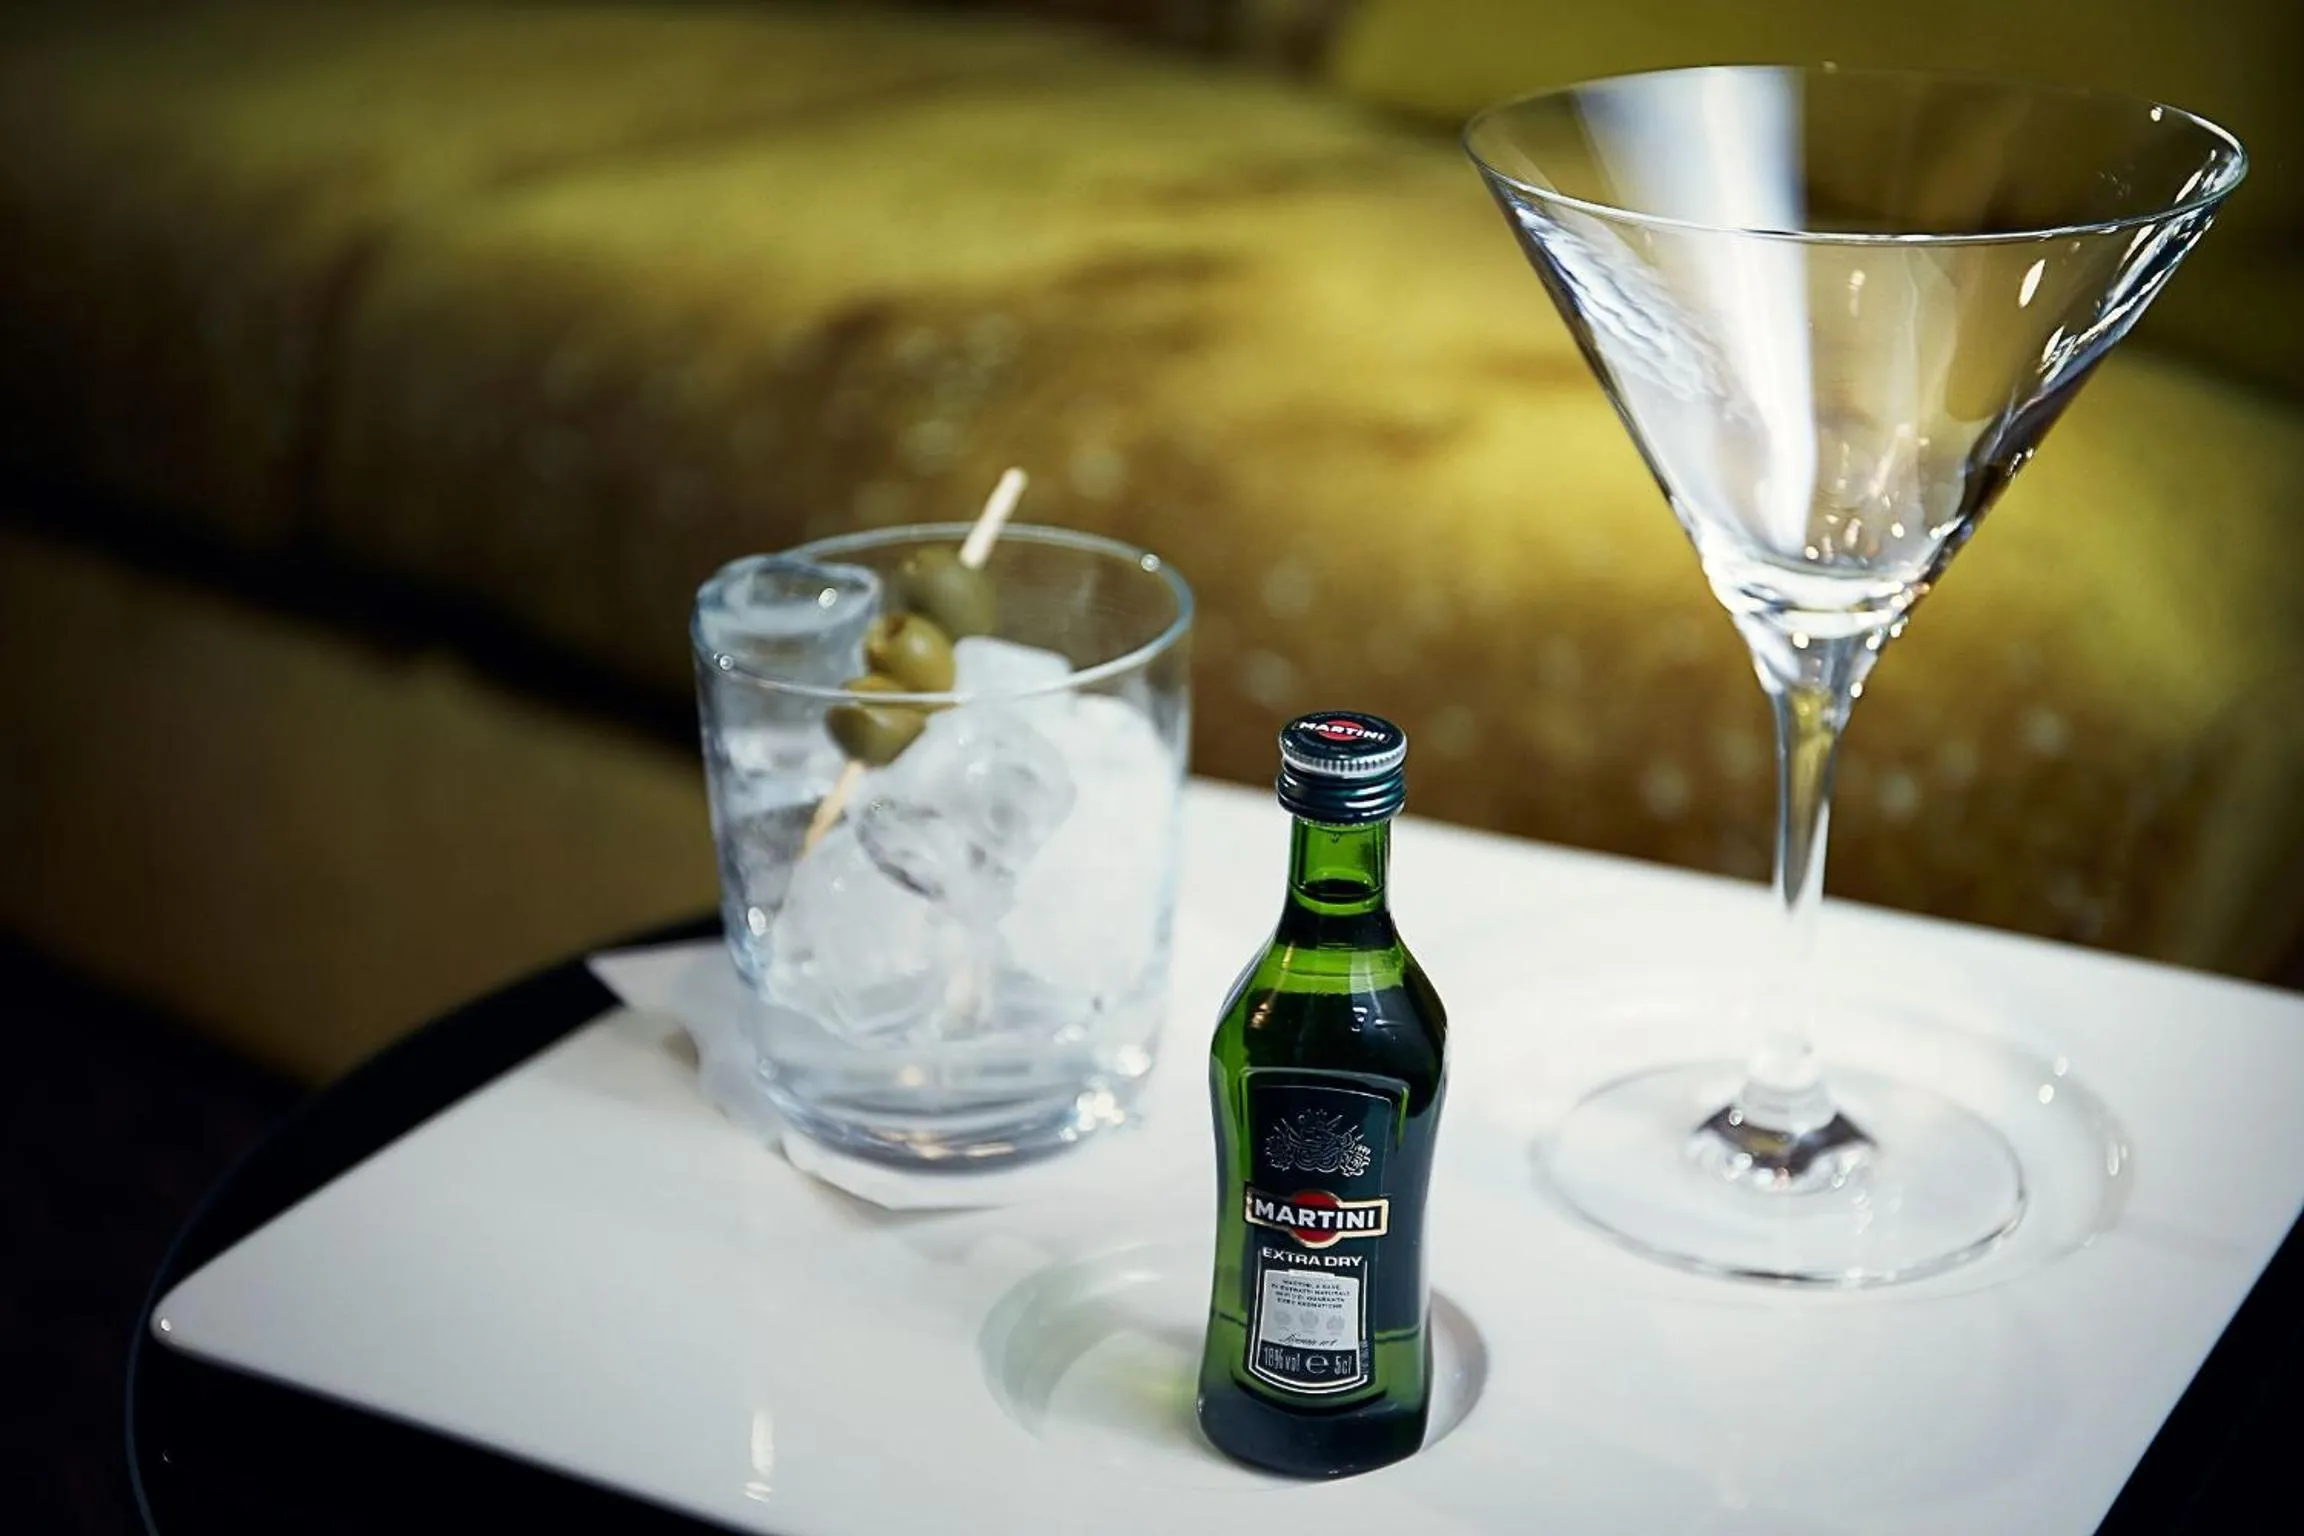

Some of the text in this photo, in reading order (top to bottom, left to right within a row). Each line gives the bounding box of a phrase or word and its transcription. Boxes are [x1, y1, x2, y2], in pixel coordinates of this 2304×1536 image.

[1299, 722, 1386, 741] MARTINI
[1255, 1198, 1376, 1229] MARTINI
[1262, 1246, 1364, 1267] EXTRA DRY
[1334, 1355, 1353, 1375] 5cl
